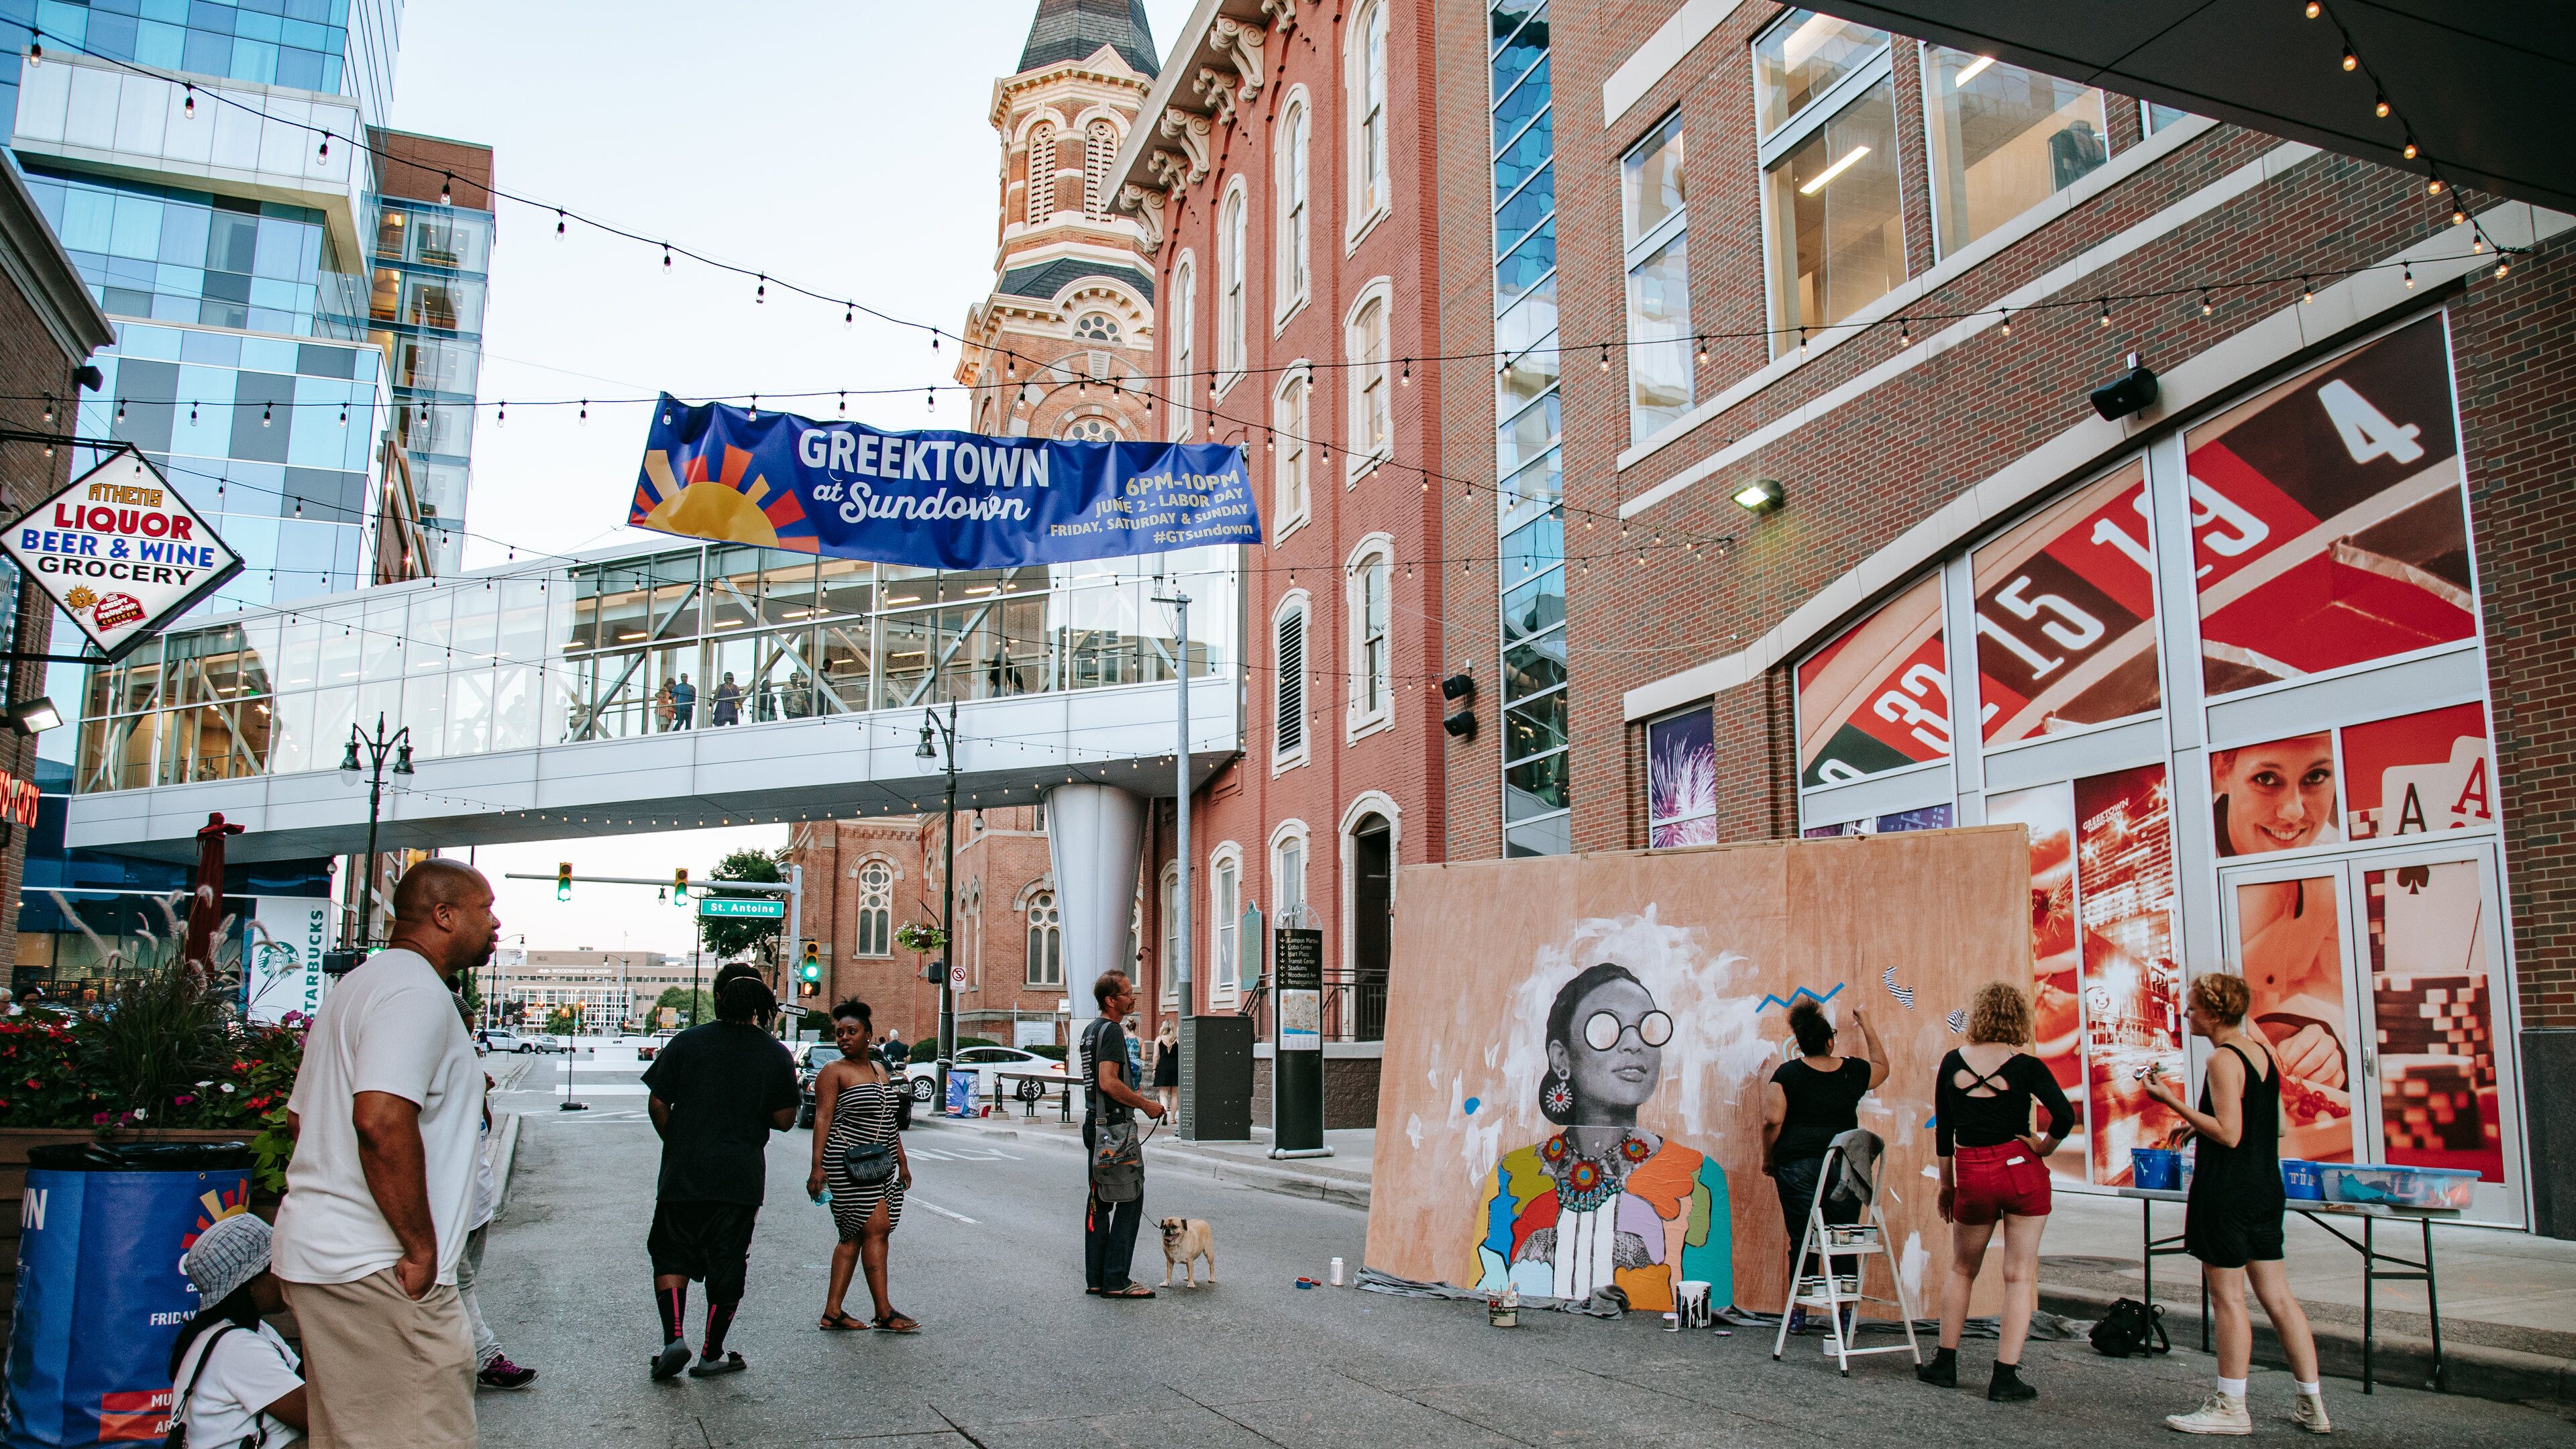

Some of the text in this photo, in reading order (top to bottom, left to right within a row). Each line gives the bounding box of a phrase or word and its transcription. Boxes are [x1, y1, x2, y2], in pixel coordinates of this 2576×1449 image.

[2318, 380, 2424, 464] 4
[798, 429, 1049, 488] GREEKTOWN
[88, 483, 163, 508] ATHENS
[1125, 470, 1240, 497] 6PM-10PM
[813, 480, 1031, 524] at Sundown
[1095, 498, 1133, 518] JUNE
[1138, 499, 1147, 513] 2
[1159, 493, 1210, 508] LABOR
[1215, 488, 1243, 503] DAY
[54, 503, 193, 541] LIQUOR
[1051, 504, 1248, 537] FRIDAY, SATURDAY & SUNDAY
[1154, 523, 1253, 545] #GTSundown
[21, 529, 215, 568] BEER & WINE
[38, 556, 195, 586] GROCERY
[99, 596, 128, 611] KRISPY
[102, 610, 138, 625] CHICKEN
[1975, 576, 2106, 680] 15
[2451, 757, 2491, 819] A
[2082, 798, 2129, 830] GREEKTOWN
[2393, 782, 2427, 836] A
[710, 903, 775, 913] St. Antoine
